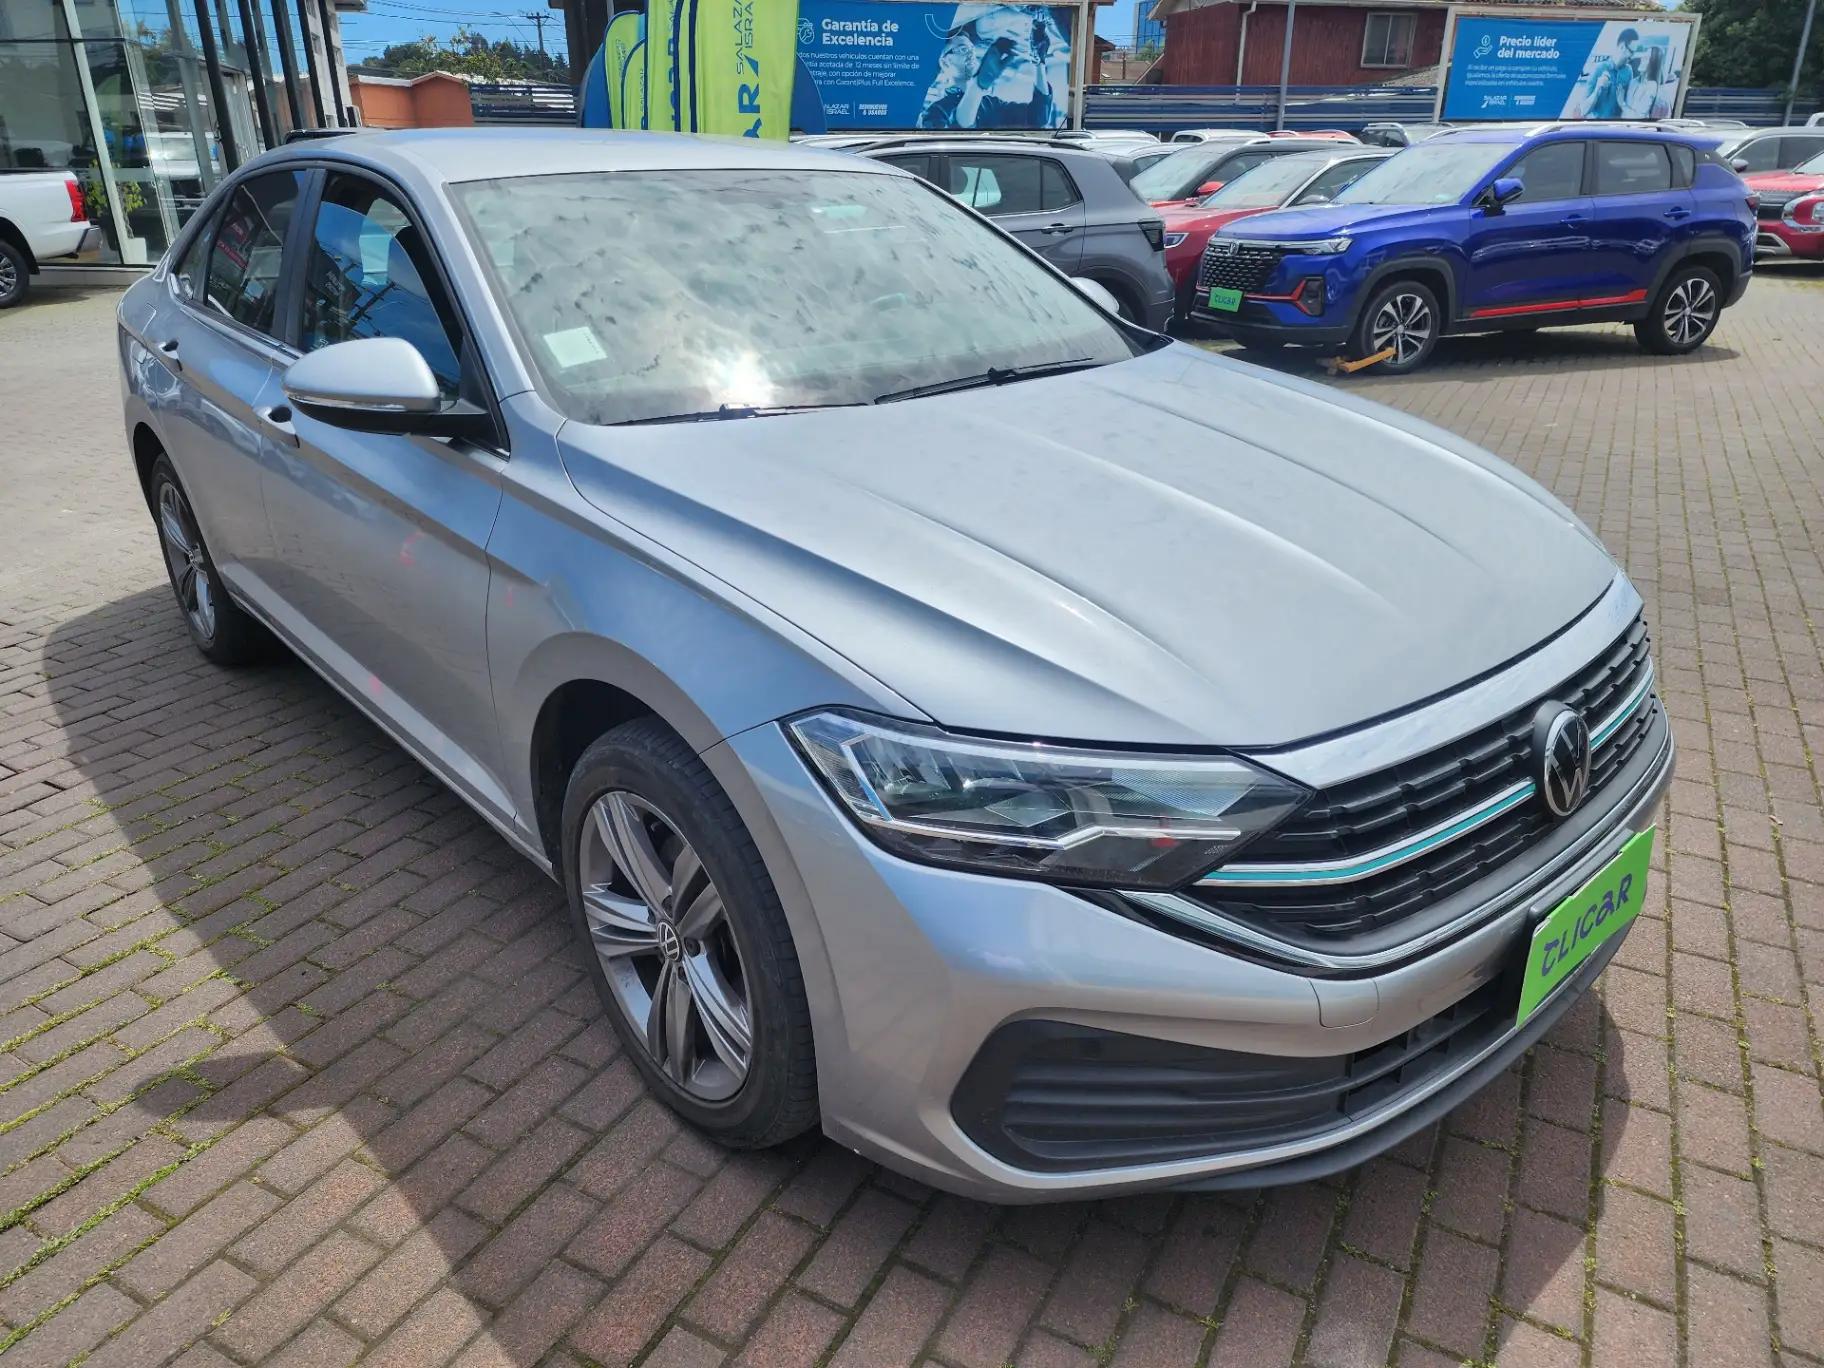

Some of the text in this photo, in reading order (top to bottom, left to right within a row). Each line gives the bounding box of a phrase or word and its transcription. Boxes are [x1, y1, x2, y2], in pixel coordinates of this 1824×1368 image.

[744, 1, 753, 48] ISRA
[822, 18, 899, 32] Garantía de
[822, 33, 894, 46] Excelencia
[1500, 35, 1557, 47] Precio líder
[1497, 47, 1560, 59] del mercado
